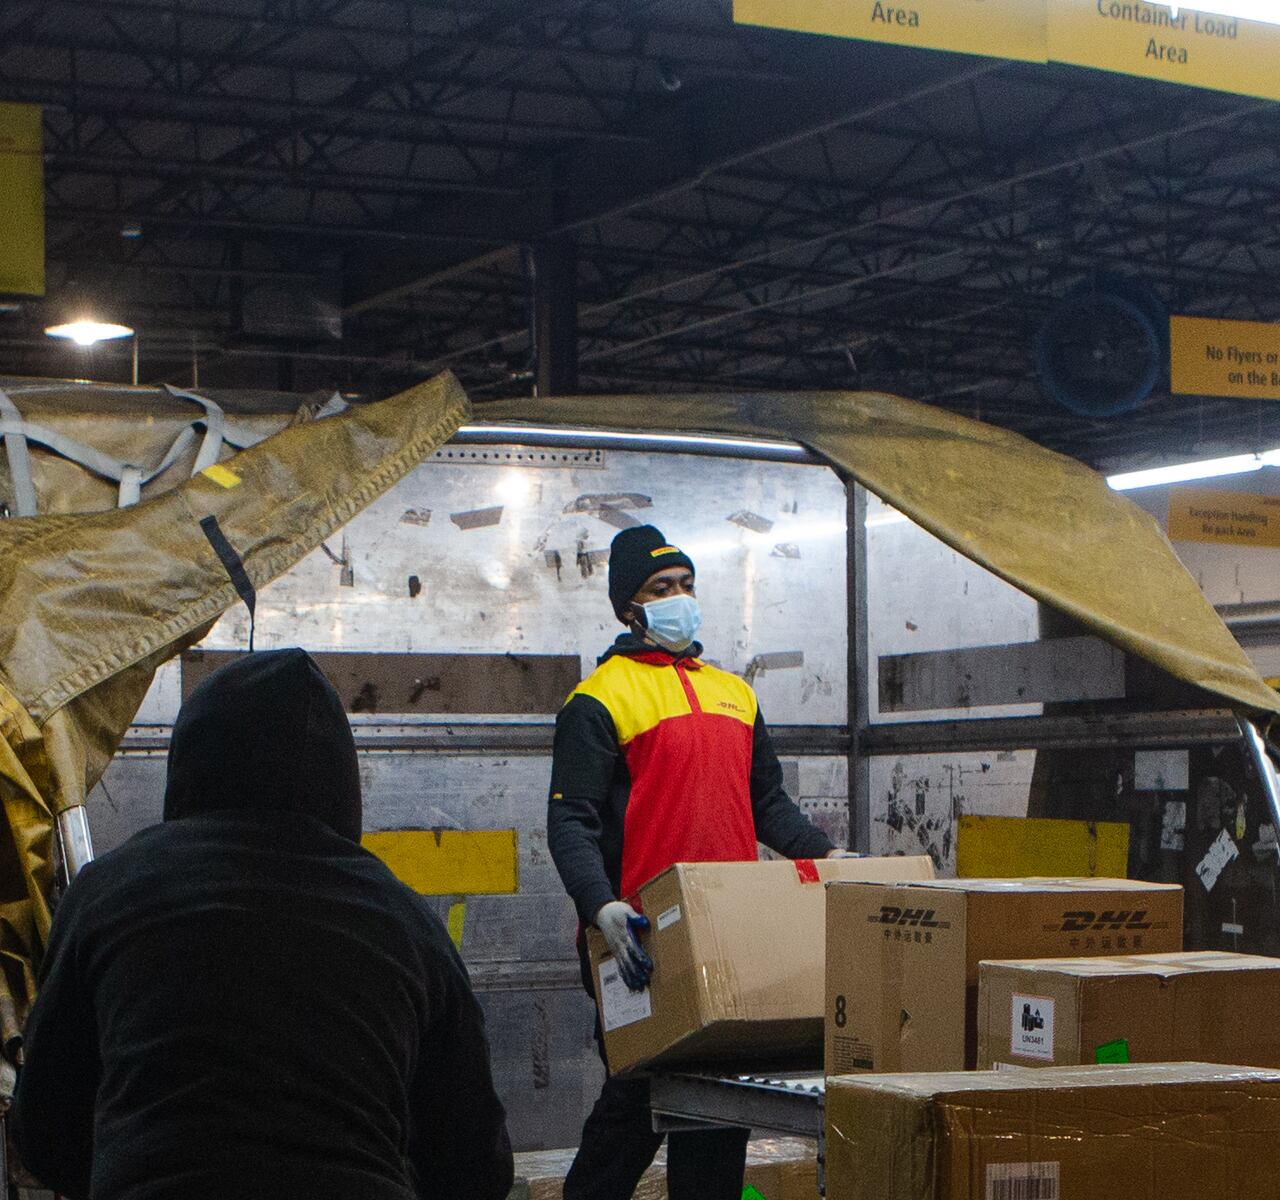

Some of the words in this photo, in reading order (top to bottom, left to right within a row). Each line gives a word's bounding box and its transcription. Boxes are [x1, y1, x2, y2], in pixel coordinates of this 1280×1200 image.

[872, 0, 919, 27] Area
[1195, 10, 1237, 39] Load
[1146, 37, 1188, 64] Area
[1206, 345, 1223, 360] No
[1228, 346, 1263, 366] Flyers
[1266, 351, 1278, 364] or
[1228, 372, 1243, 384] on
[1248, 371, 1267, 386] the
[880, 906, 939, 928] DHL
[1061, 910, 1152, 931] DHL
[835, 995, 847, 1028] 8
